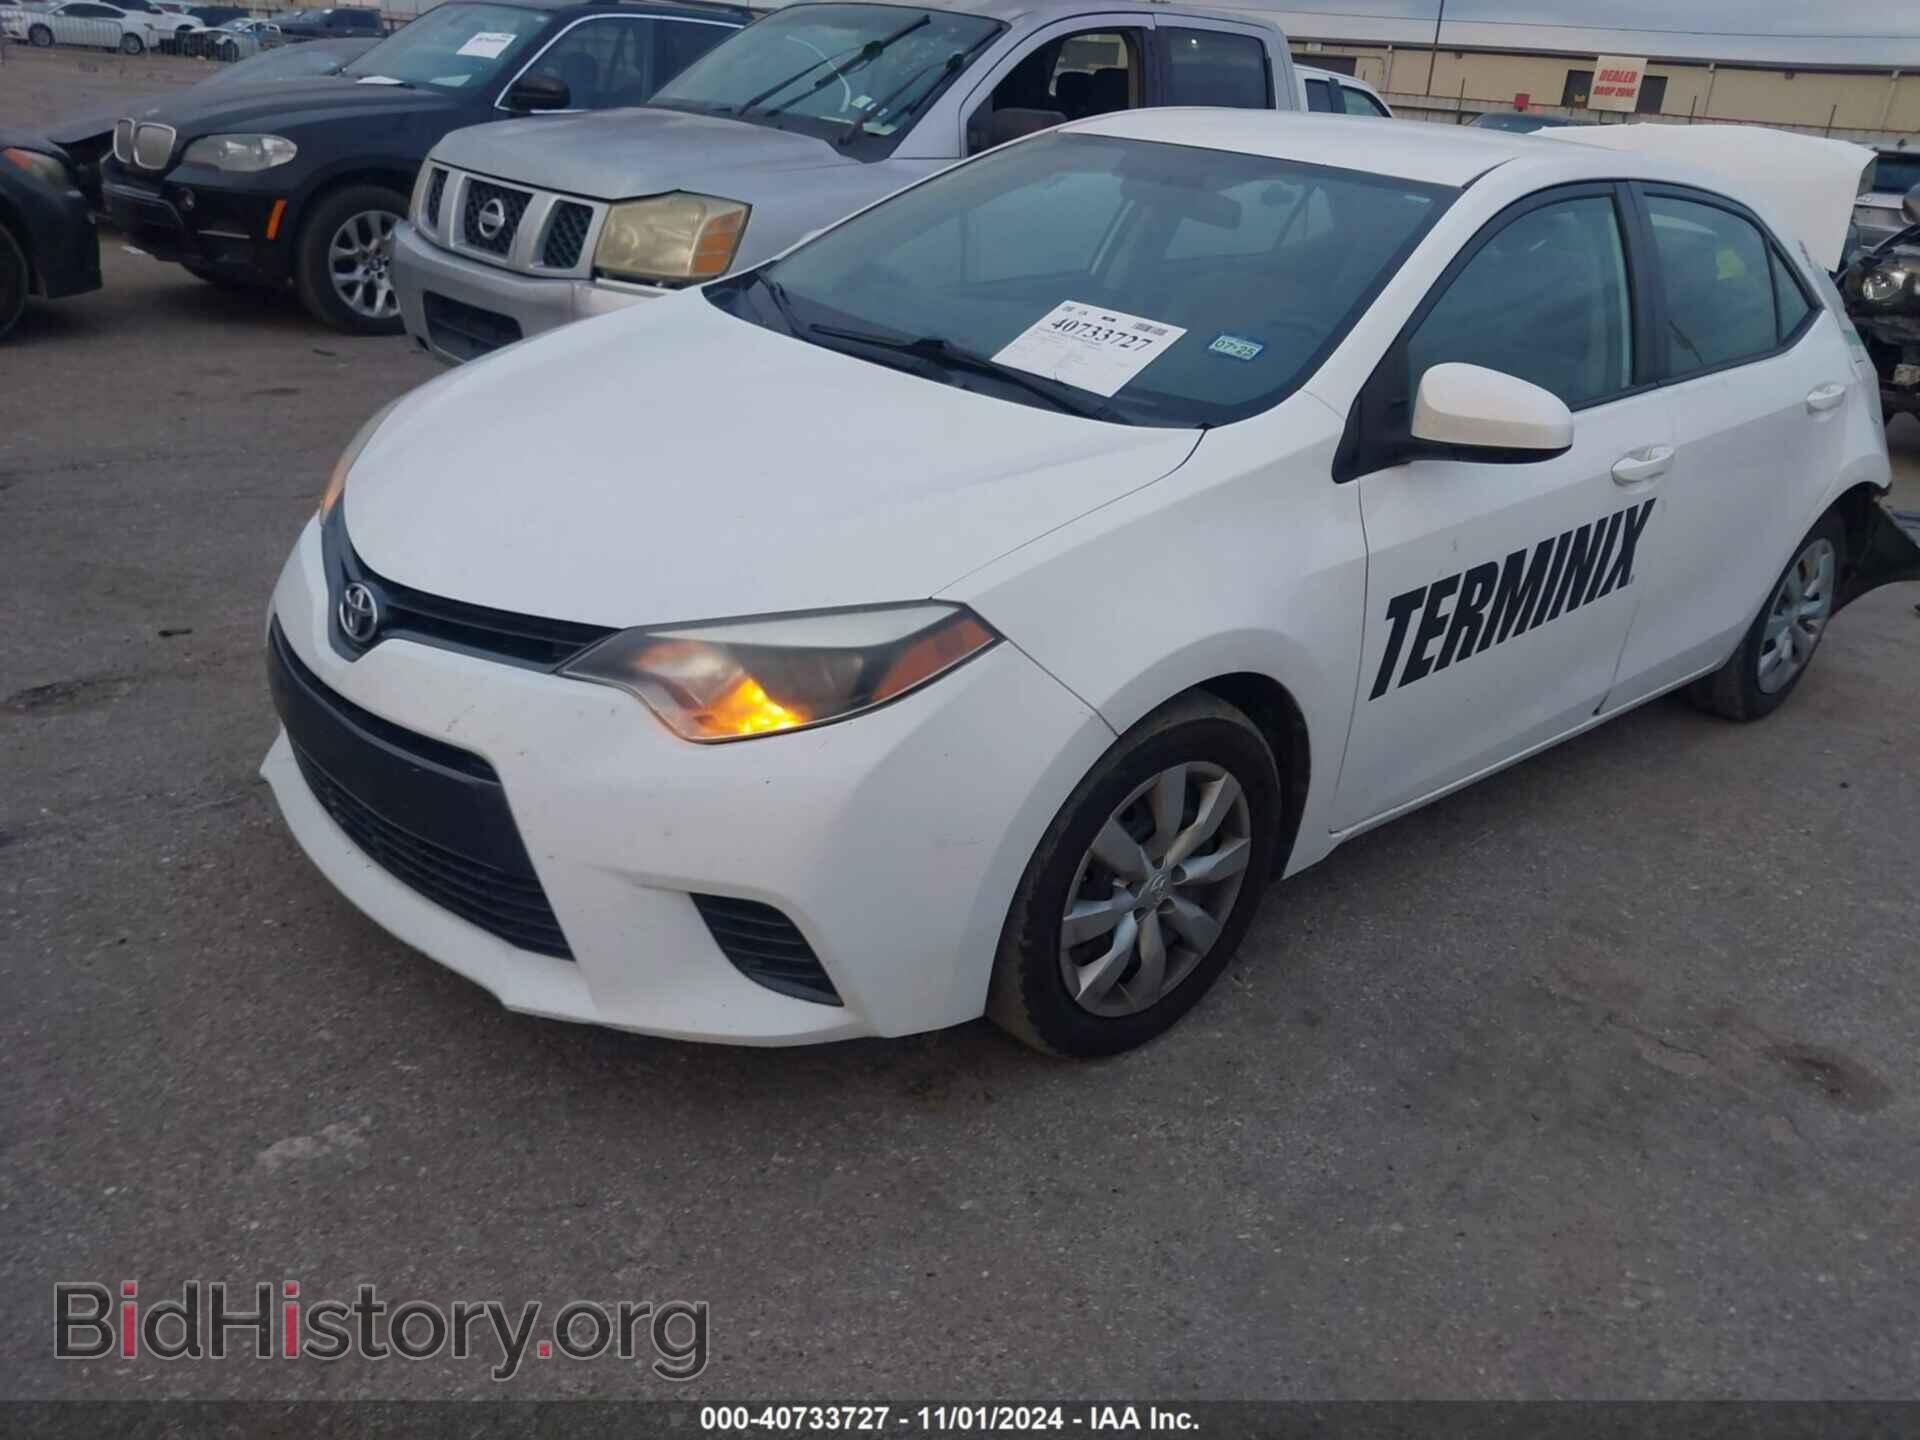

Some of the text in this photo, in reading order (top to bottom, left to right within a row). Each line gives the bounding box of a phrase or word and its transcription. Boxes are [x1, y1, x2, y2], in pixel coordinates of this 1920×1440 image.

[1599, 69, 1638, 84] DEALER
[1593, 86, 1637, 98] DROP ZONE
[1050, 318, 1154, 352] 40733727
[1368, 498, 1657, 702] TERMINIX
